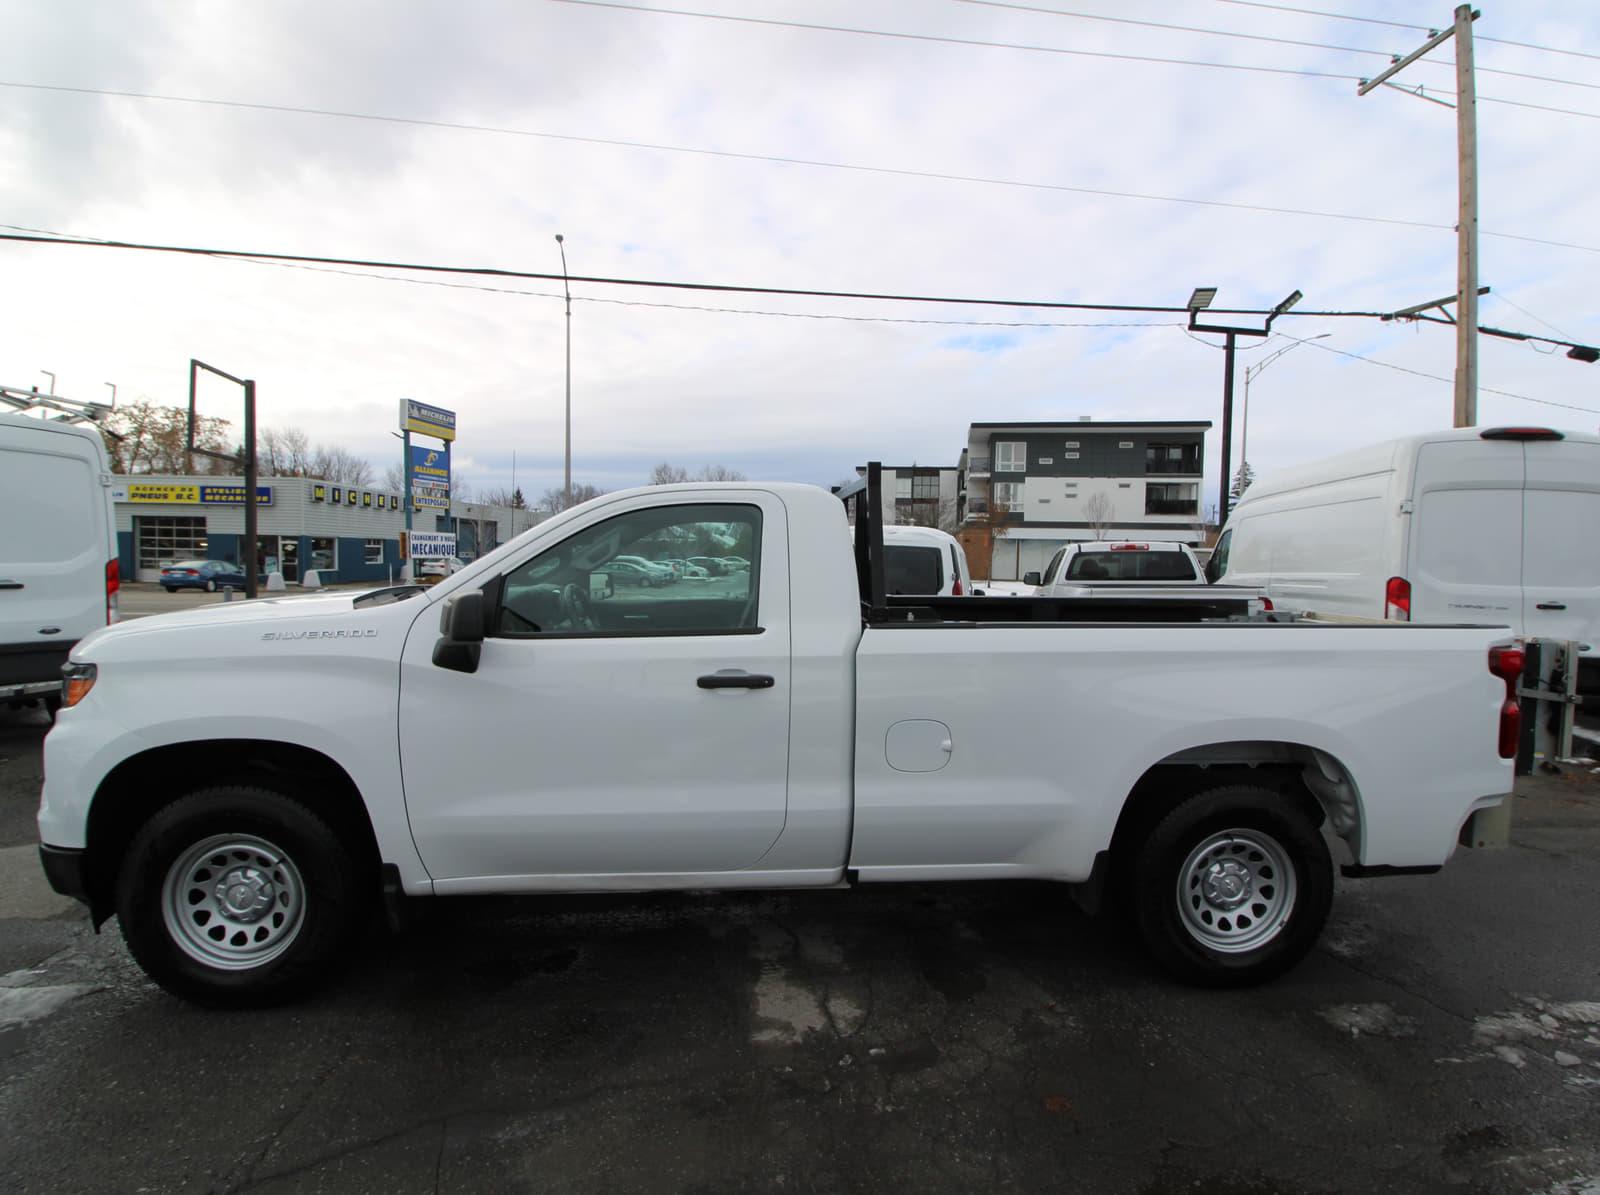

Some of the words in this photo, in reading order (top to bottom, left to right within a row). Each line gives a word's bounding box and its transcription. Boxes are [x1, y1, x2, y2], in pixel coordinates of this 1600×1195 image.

[314, 486, 398, 509] MICHEL
[412, 543, 456, 556] MECANIQUE
[261, 629, 378, 641] SILVERADO
